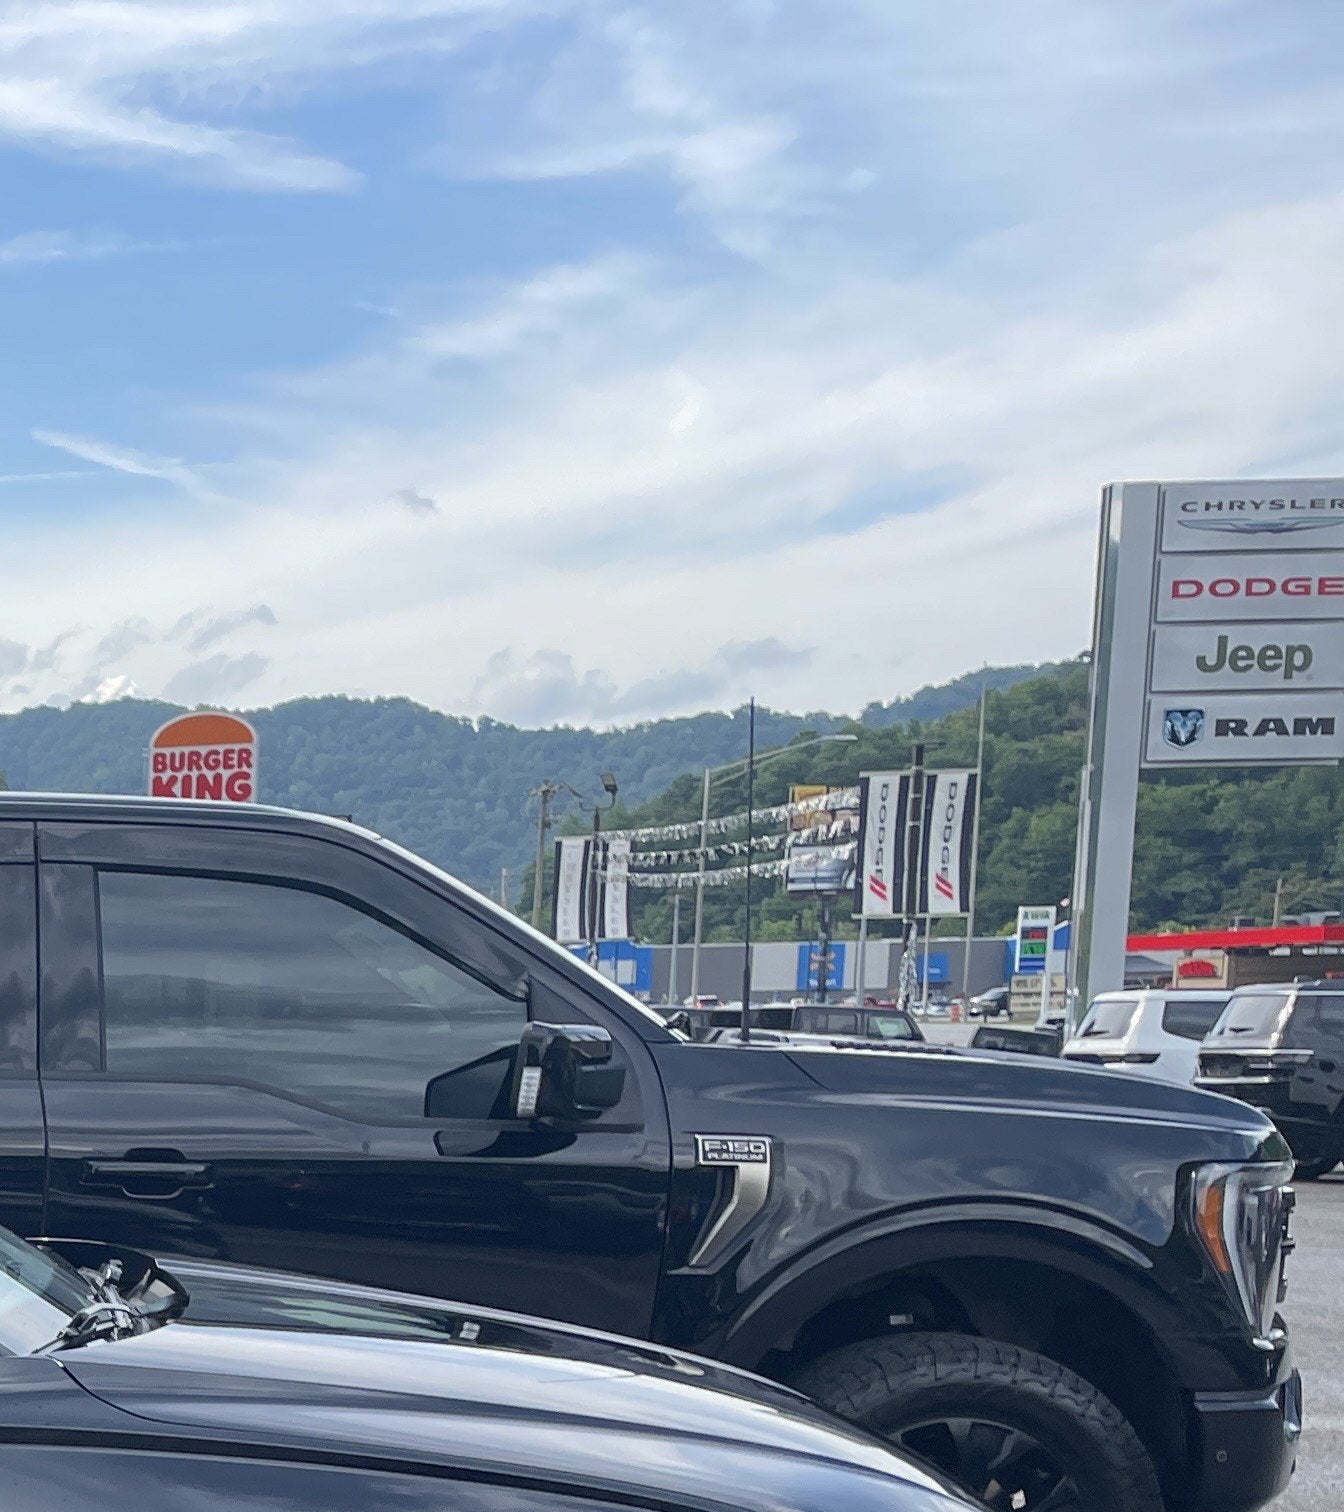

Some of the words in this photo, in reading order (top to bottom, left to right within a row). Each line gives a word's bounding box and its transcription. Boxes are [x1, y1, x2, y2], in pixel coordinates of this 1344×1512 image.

[1180, 498, 1344, 513] CHRYSLER
[1171, 576, 1344, 599] DODGE
[1195, 634, 1314, 680] Jeep
[1214, 716, 1336, 738] RAM
[153, 749, 252, 773] BURGER
[152, 771, 252, 801] KING
